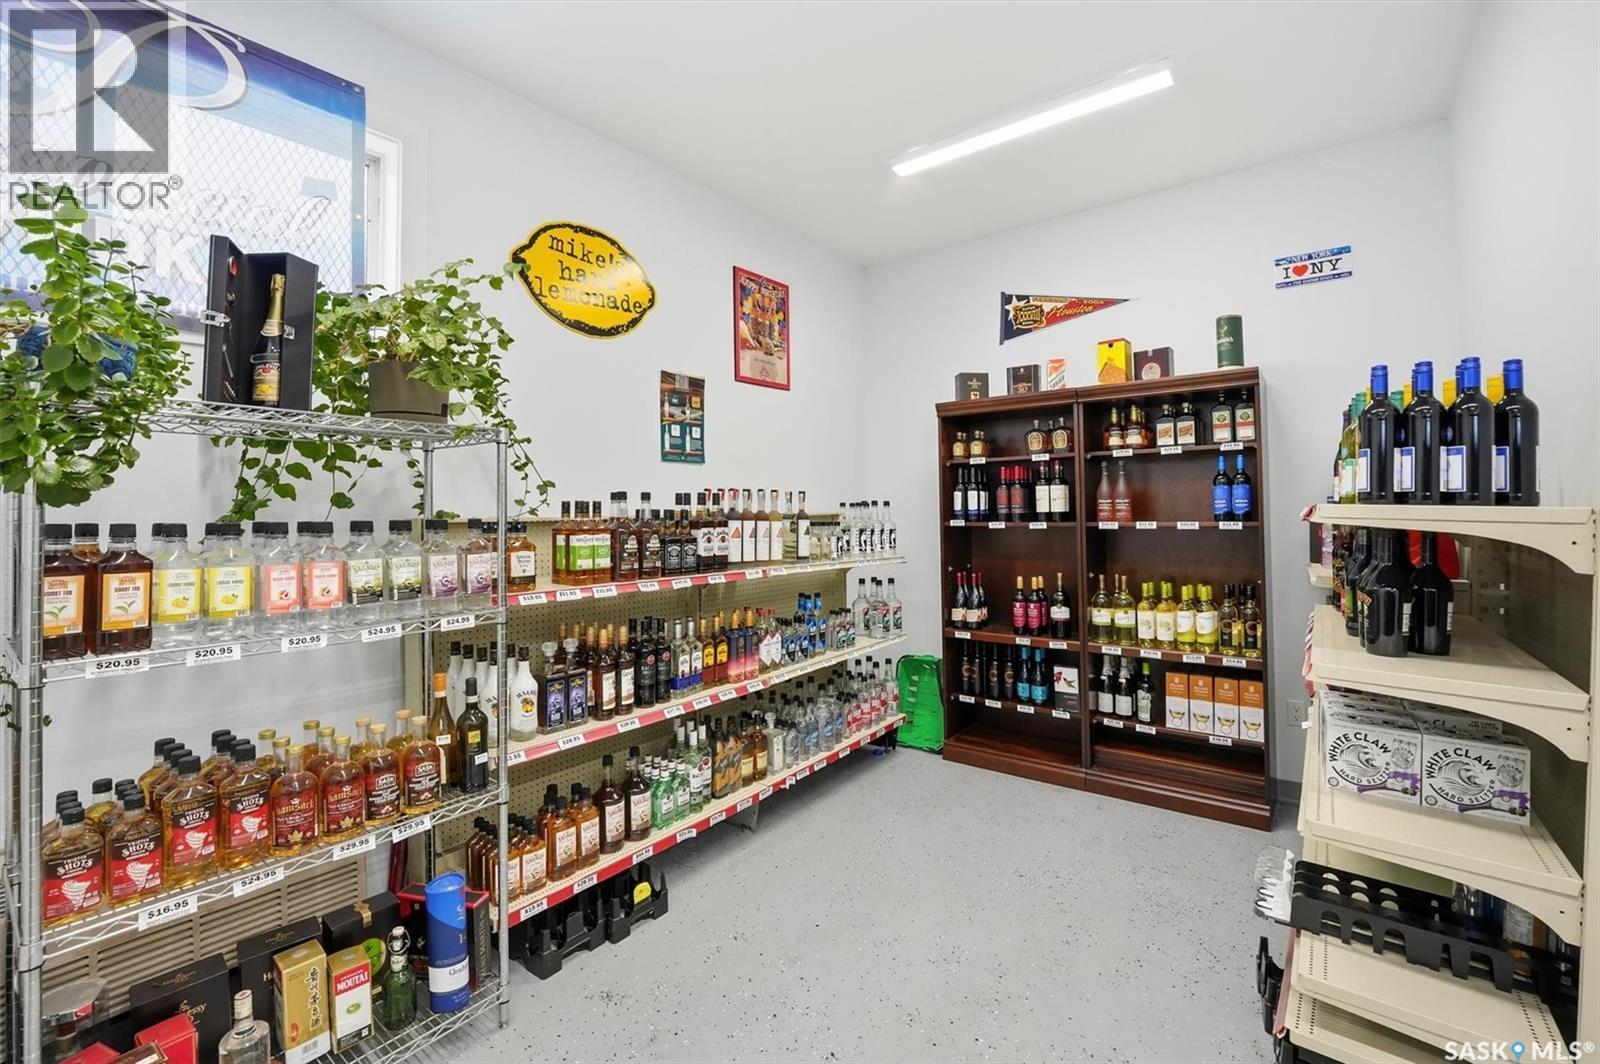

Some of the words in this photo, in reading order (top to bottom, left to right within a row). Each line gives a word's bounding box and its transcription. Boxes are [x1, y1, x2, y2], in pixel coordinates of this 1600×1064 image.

[1292, 253, 1308, 262] NEW
[1312, 250, 1331, 259] YORK
[1283, 267, 1291, 279] I
[1309, 258, 1342, 274] NY
[534, 275, 644, 314] lemonade
[1047, 304, 1094, 319] Houston
[446, 616, 471, 626] $24.95
[367, 625, 397, 636] $24.95
[288, 635, 321, 646] $20.95
[195, 647, 233, 658] $20.95
[96, 658, 141, 670] $20.95
[1328, 733, 1352, 762] WHITE
[1354, 731, 1391, 754] CLAW
[1425, 748, 1452, 780] WHITE
[1453, 747, 1497, 771] CLAW
[1339, 768, 1363, 784] HARD
[1438, 786, 1464, 803] HARD
[236, 797, 264, 811] SHOTS
[179, 811, 210, 826] SHOTS
[398, 819, 425, 835] $29.95
[122, 842, 155, 857] SHOTS
[340, 838, 371, 853] $29.95
[57, 859, 94, 876] SHOTS
[241, 870, 277, 887] $24.95
[147, 900, 189, 920] $16.95
[336, 971, 368, 992] MOUTAI
